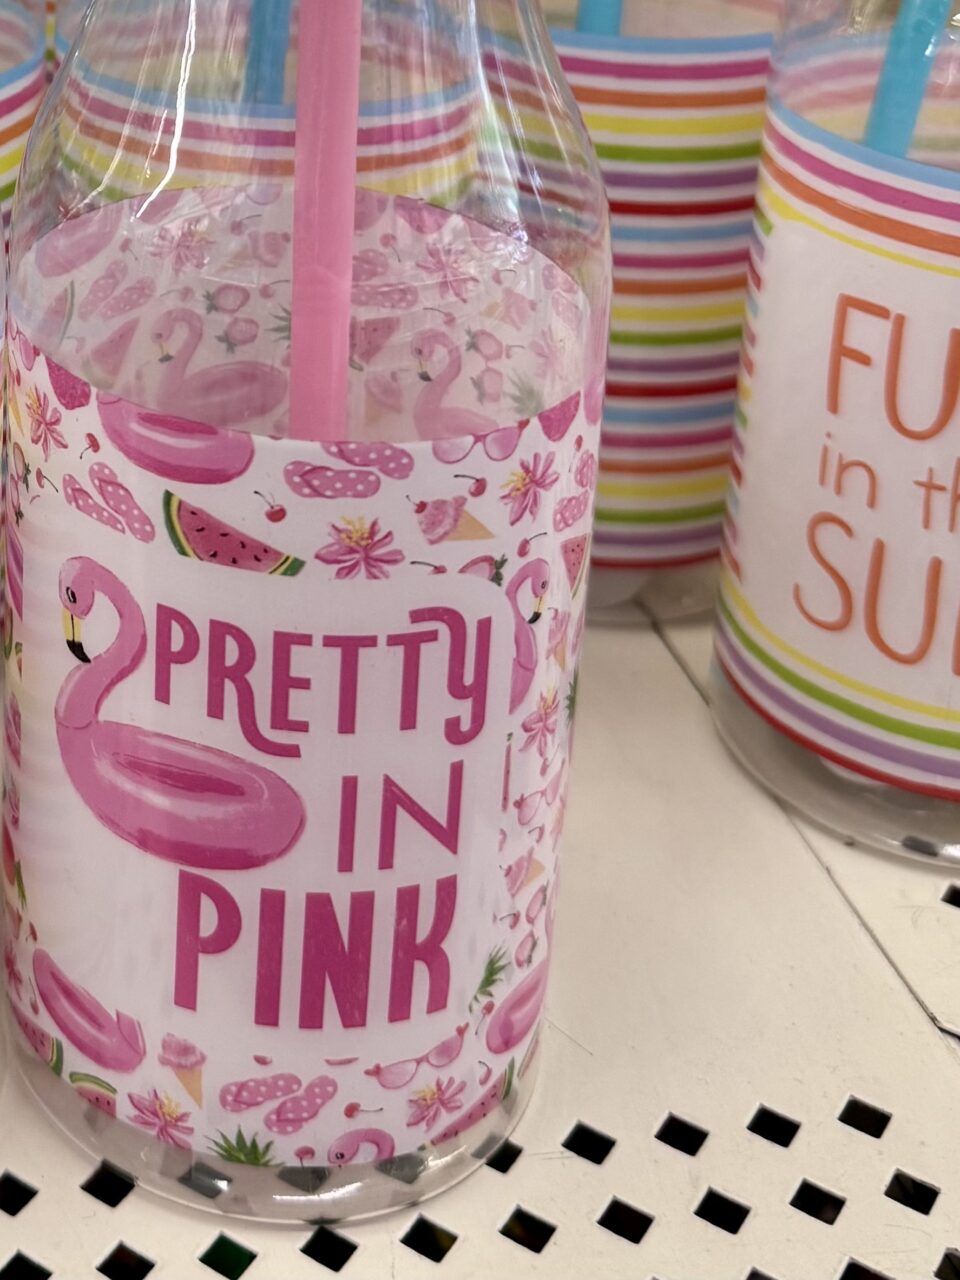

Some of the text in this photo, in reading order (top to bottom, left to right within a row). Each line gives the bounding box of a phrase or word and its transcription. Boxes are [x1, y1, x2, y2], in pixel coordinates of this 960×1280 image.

[826, 292, 960, 442] FU
[817, 431, 878, 510] in
[792, 510, 960, 677] SU
[154, 603, 492, 758] PRETTY
[337, 759, 464, 873] IN
[173, 869, 458, 1030] PINK
